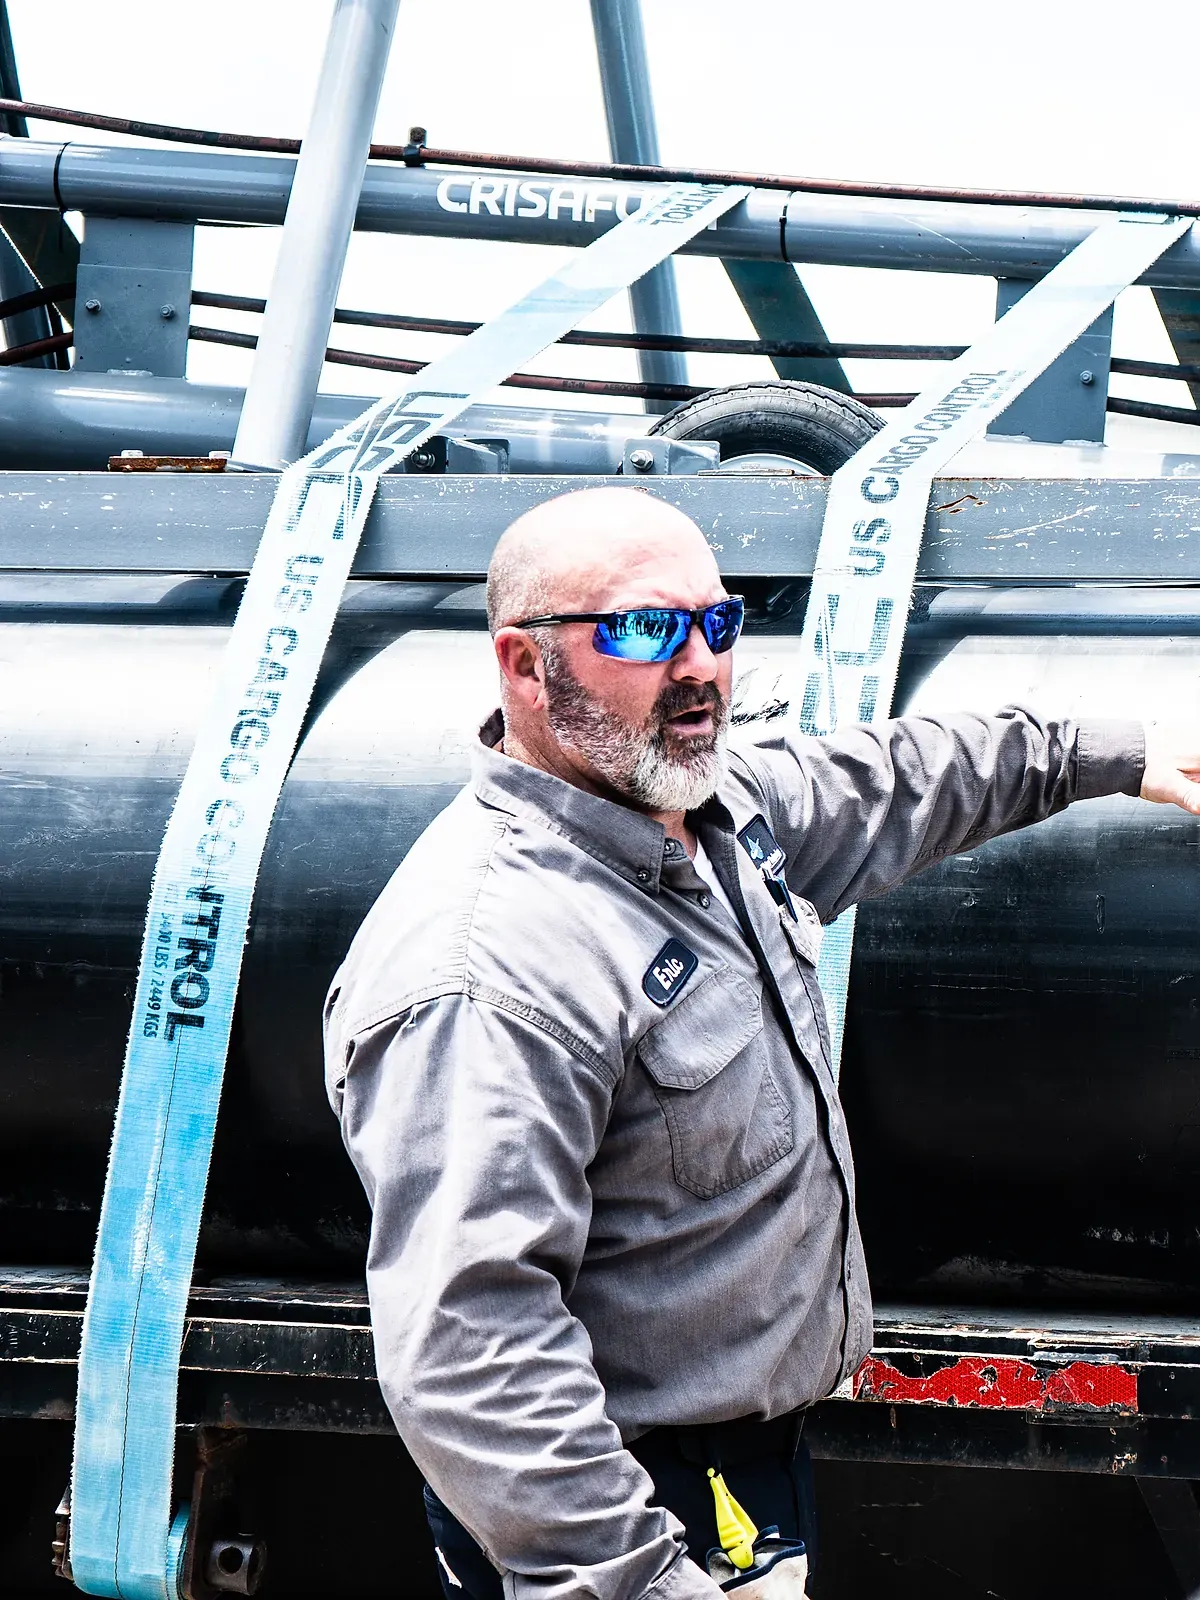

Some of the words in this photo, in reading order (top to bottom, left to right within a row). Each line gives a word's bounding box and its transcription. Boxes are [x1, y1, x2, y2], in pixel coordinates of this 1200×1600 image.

[436, 174, 718, 231] CRISAFU
[914, 370, 1007, 432] CONTROL
[860, 435, 939, 504] CARGO
[849, 517, 892, 578] US
[273, 554, 325, 614] US
[219, 625, 299, 784] CARGO
[163, 799, 246, 1043] CONTROL
[154, 945, 170, 970] LBS
[147, 976, 162, 1011] 2449
[143, 1011, 161, 1040] KGS
